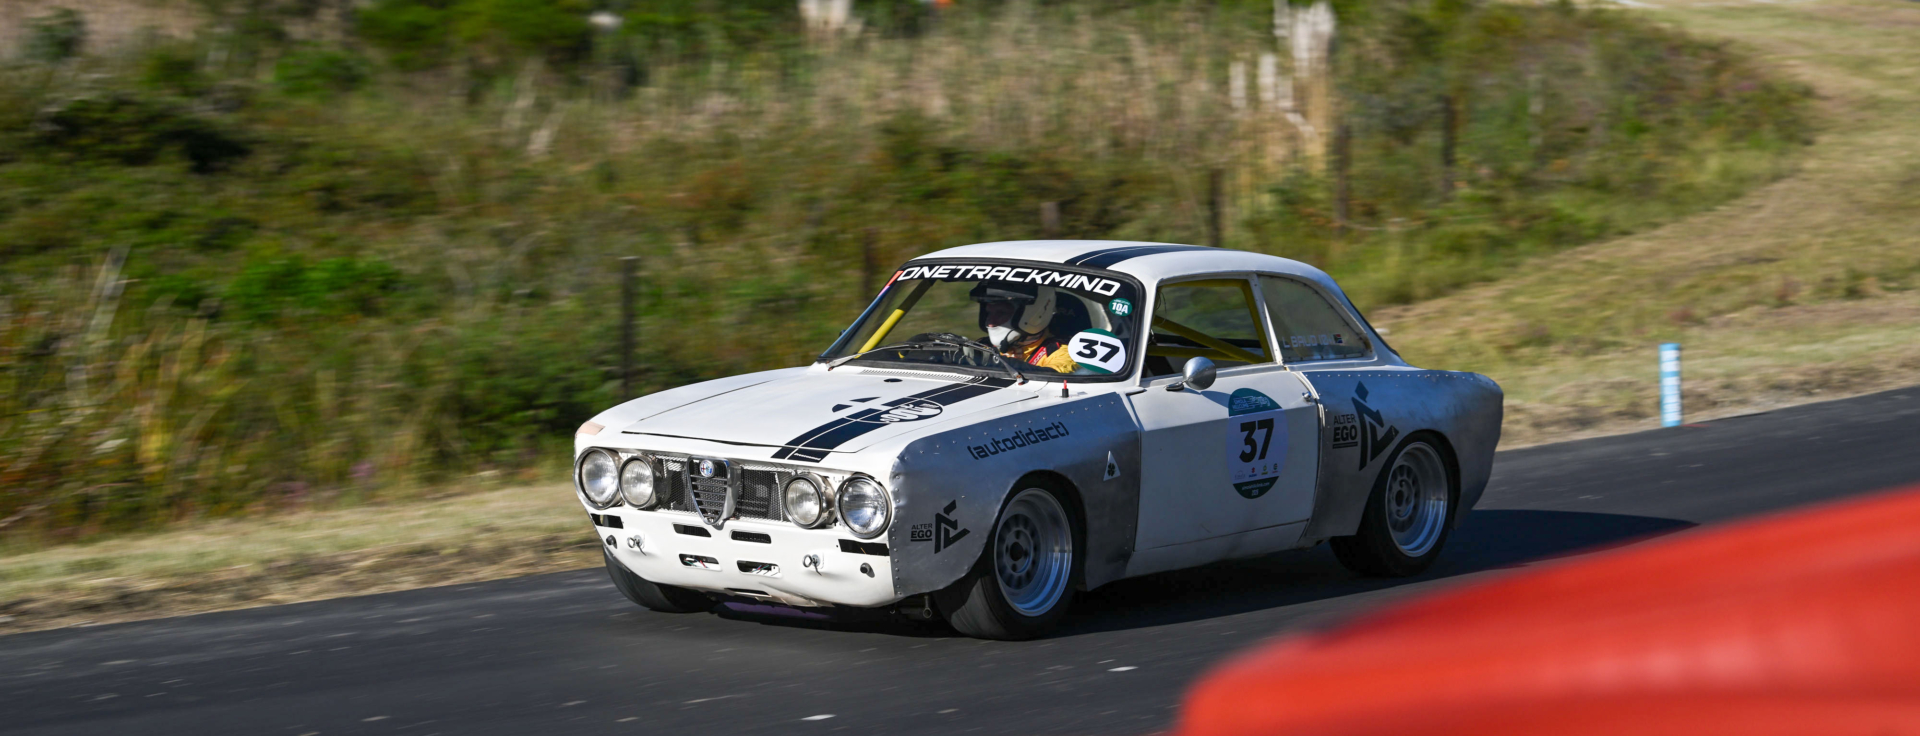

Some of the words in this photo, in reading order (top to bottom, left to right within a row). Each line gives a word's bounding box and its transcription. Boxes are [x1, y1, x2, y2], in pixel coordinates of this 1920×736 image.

[897, 265, 1121, 297] ONETRACKMIND
[1111, 302, 1129, 314] 10A
[1076, 338, 1120, 364] 37
[1333, 413, 1356, 425] ALTER
[967, 421, 1069, 460] (autodidact)
[1239, 418, 1275, 463] 37
[1333, 425, 1358, 442] EGO
[911, 529, 933, 539] EGO
